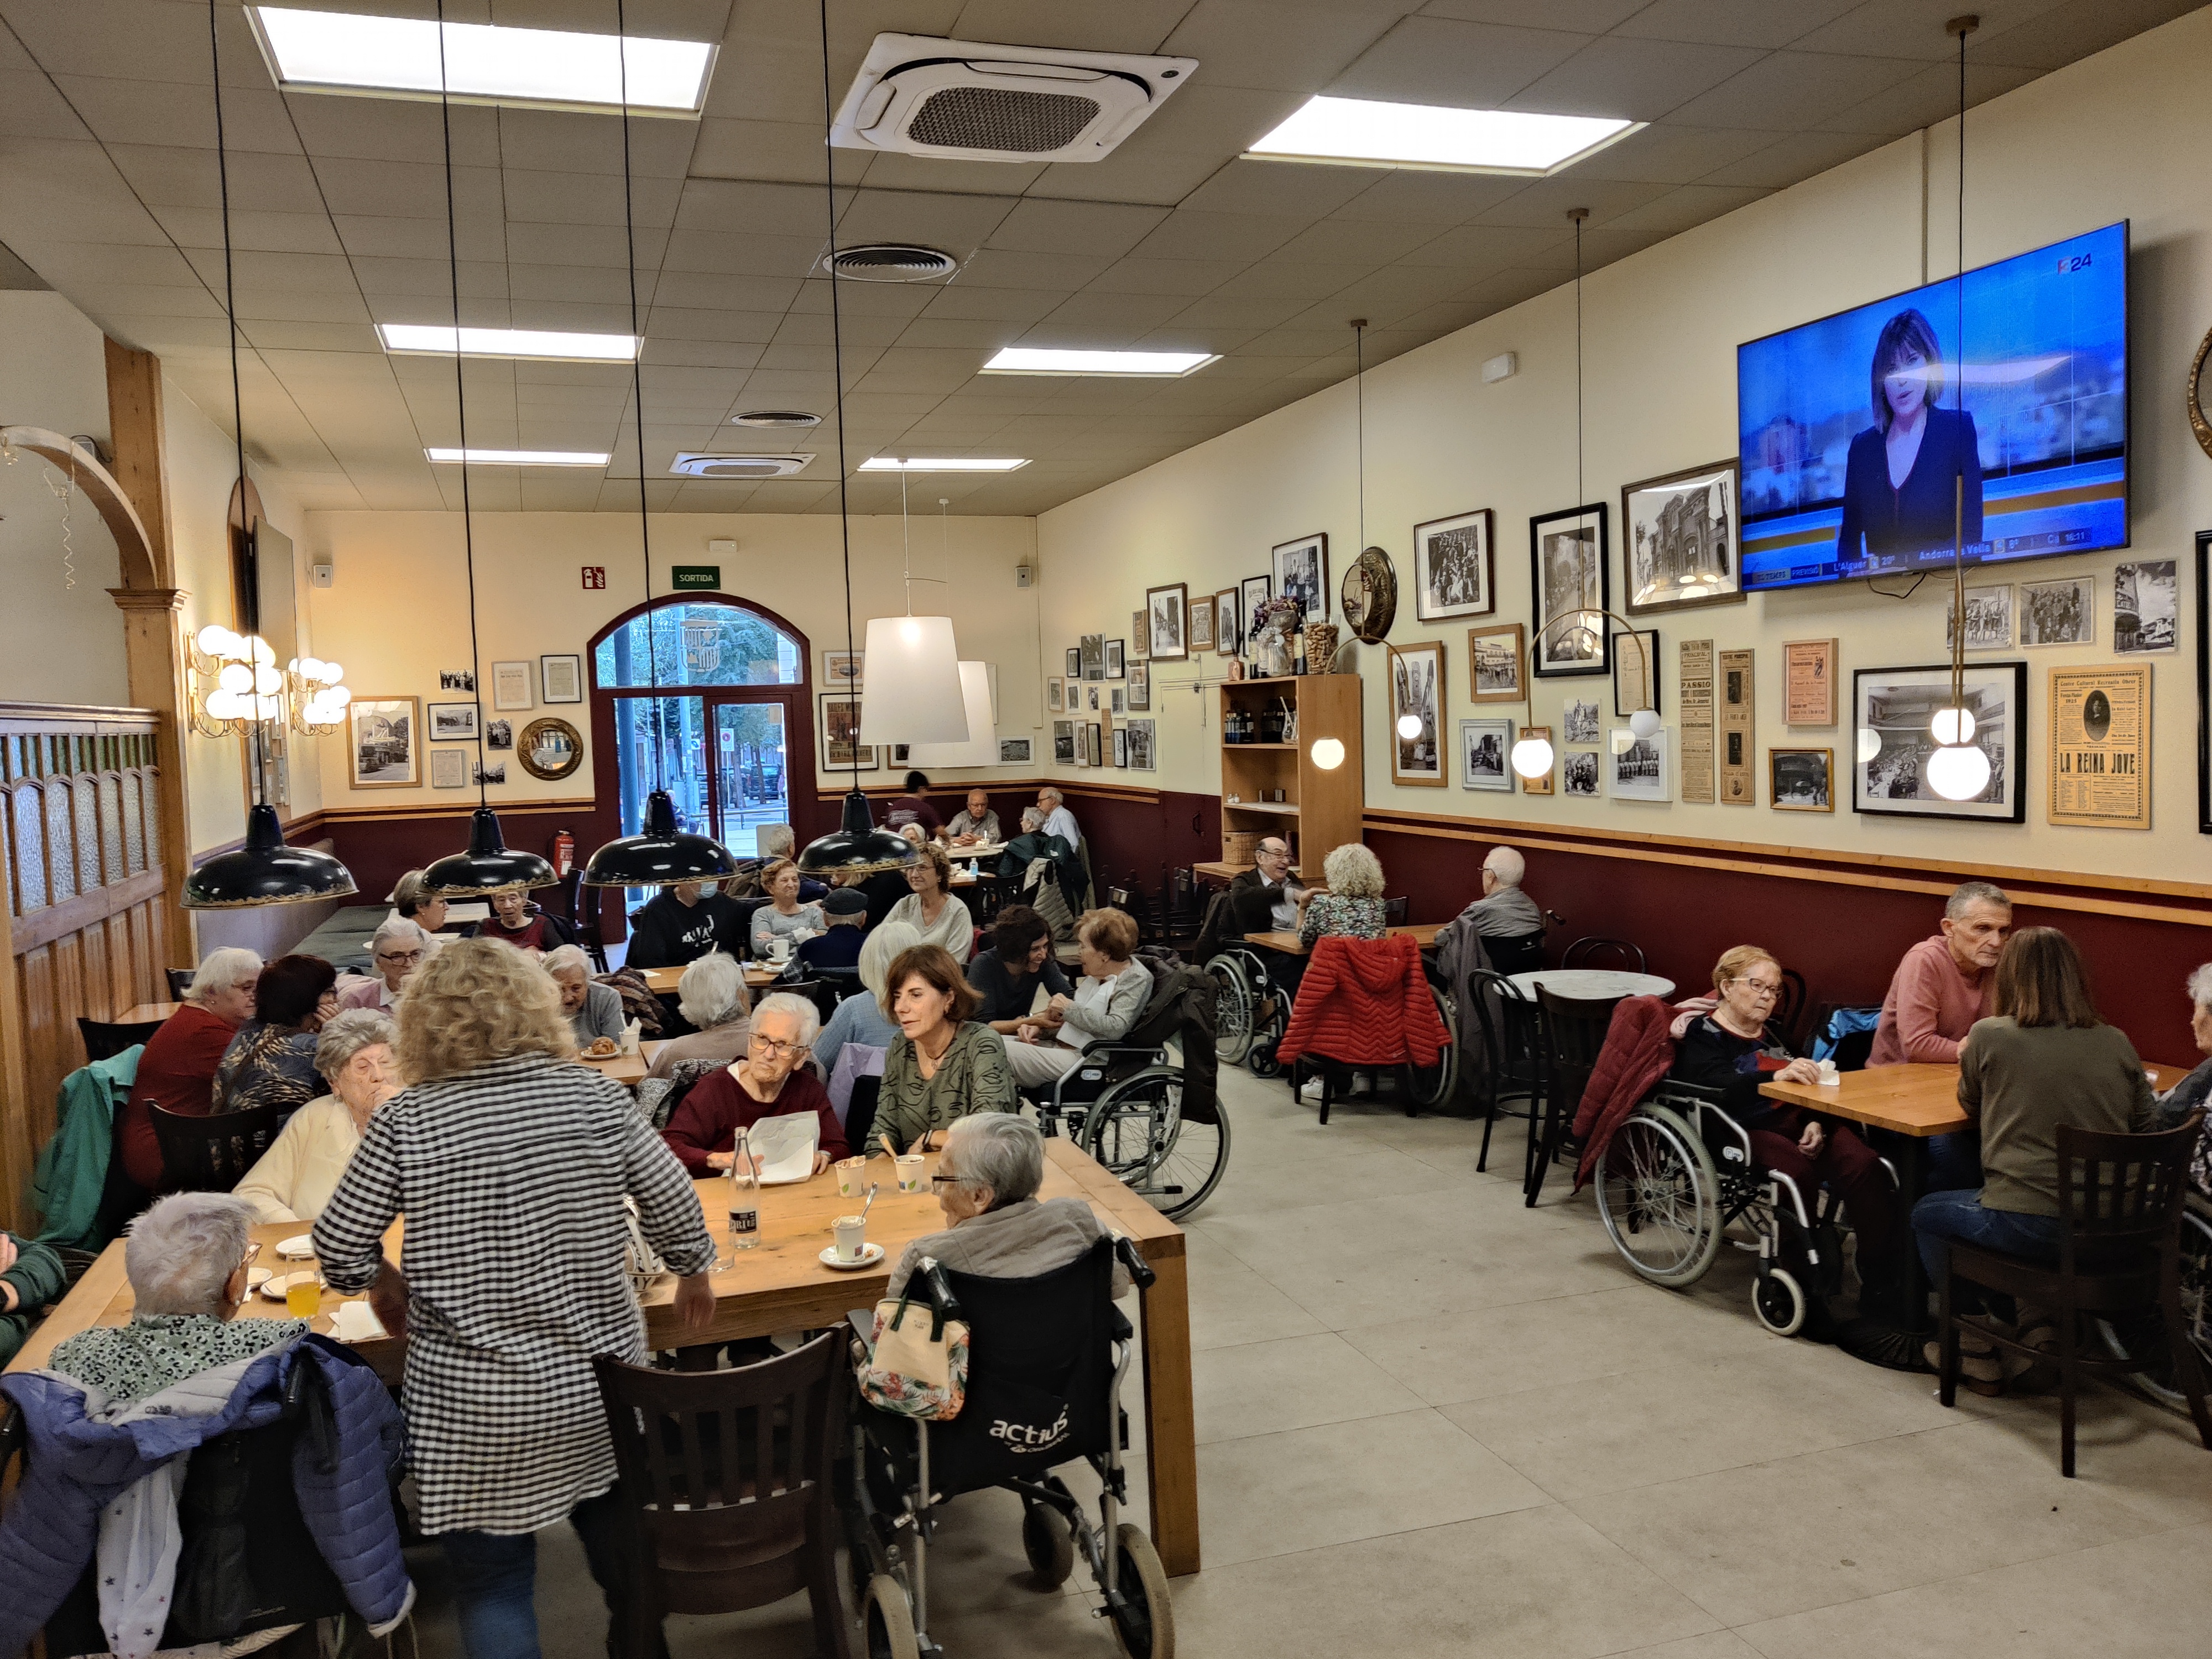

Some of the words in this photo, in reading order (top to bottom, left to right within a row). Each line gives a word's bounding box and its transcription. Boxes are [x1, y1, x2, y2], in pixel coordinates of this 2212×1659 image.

[1919, 549, 1954, 561] Andorra
[679, 574, 714, 582] SORTIDA
[2059, 753, 2071, 773] LA
[2077, 753, 2105, 774] REINA
[2111, 753, 2135, 774] JOVE
